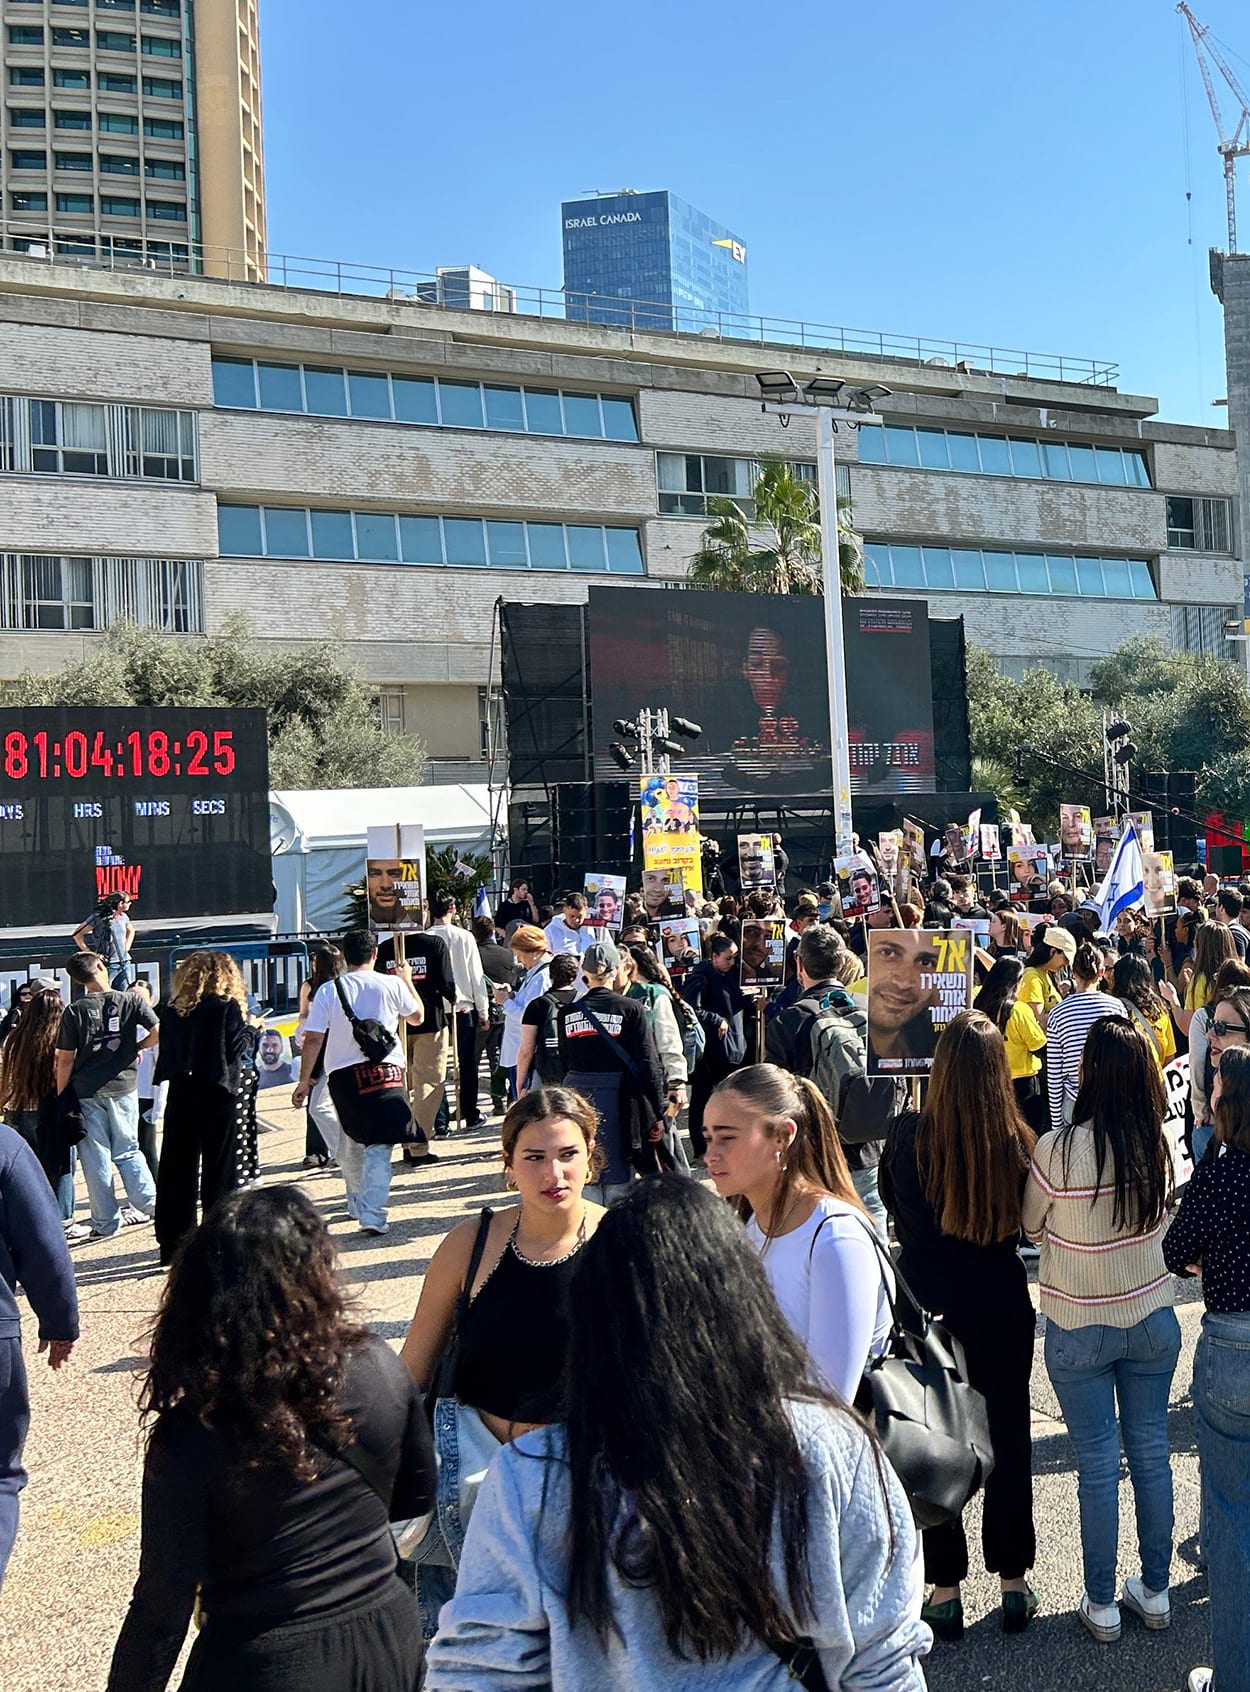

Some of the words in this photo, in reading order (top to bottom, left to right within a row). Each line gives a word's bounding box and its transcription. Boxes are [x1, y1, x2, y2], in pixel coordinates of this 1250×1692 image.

[565, 216, 598, 229] ISRAEL
[600, 211, 642, 225] CANADA
[732, 240, 747, 264] EY
[4, 730, 236, 780] 81:04:18:25
[74, 803, 103, 818] HRS
[135, 802, 171, 816] MINS
[192, 800, 226, 815] SECS
[400, 863, 418, 881] אל
[770, 922, 784, 940] אל
[932, 935, 967, 973] אל
[920, 973, 967, 990] תשאירו
[938, 990, 967, 1006] אותי
